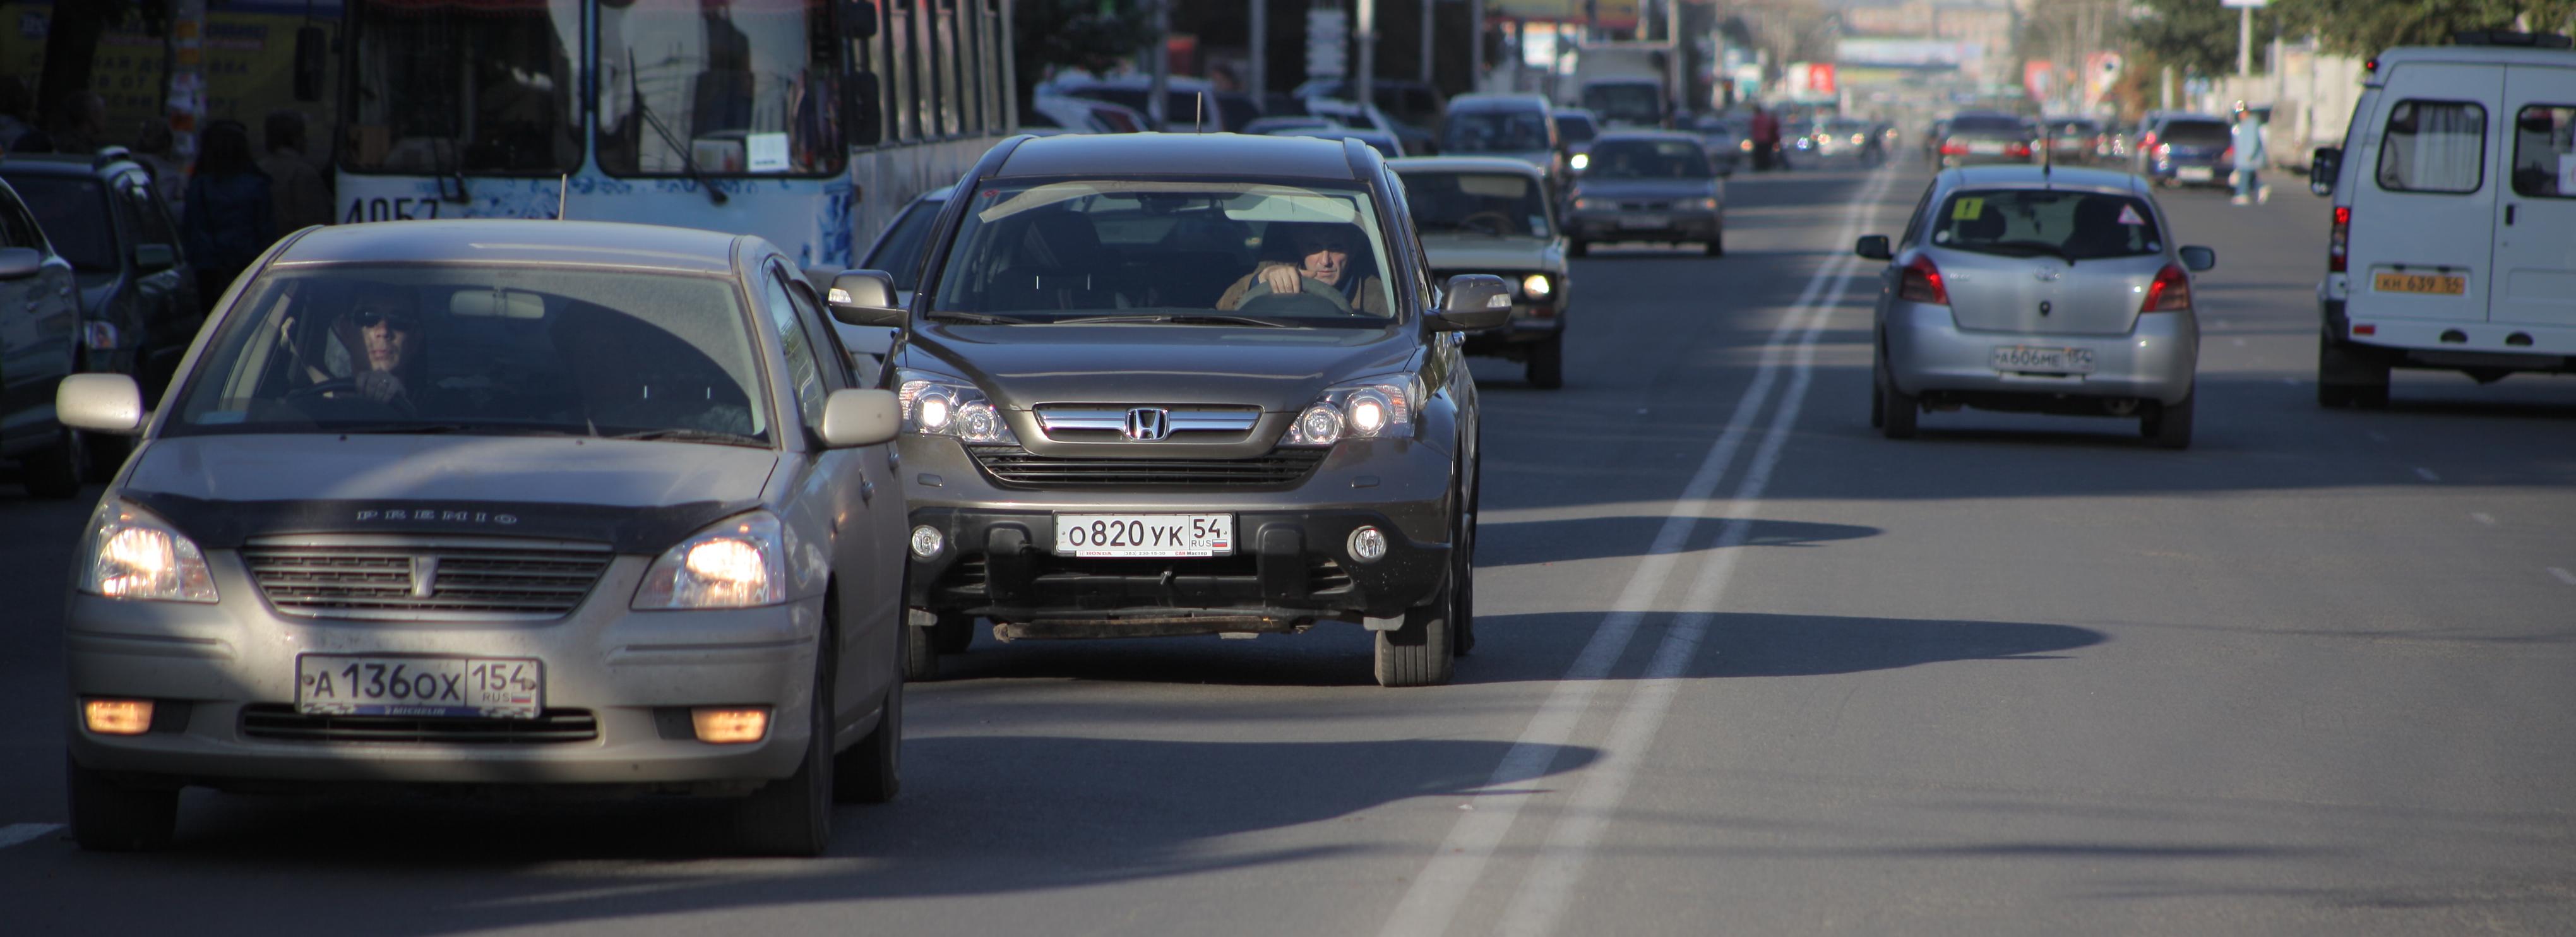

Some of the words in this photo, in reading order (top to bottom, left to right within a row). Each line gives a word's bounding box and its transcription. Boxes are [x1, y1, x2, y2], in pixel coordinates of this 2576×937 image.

[356, 510, 517, 524] PREMIO
[1193, 518, 1220, 539] 54
[472, 664, 529, 691] 154
[482, 691, 510, 702] RUS
[393, 706, 446, 716] MICHELIN
